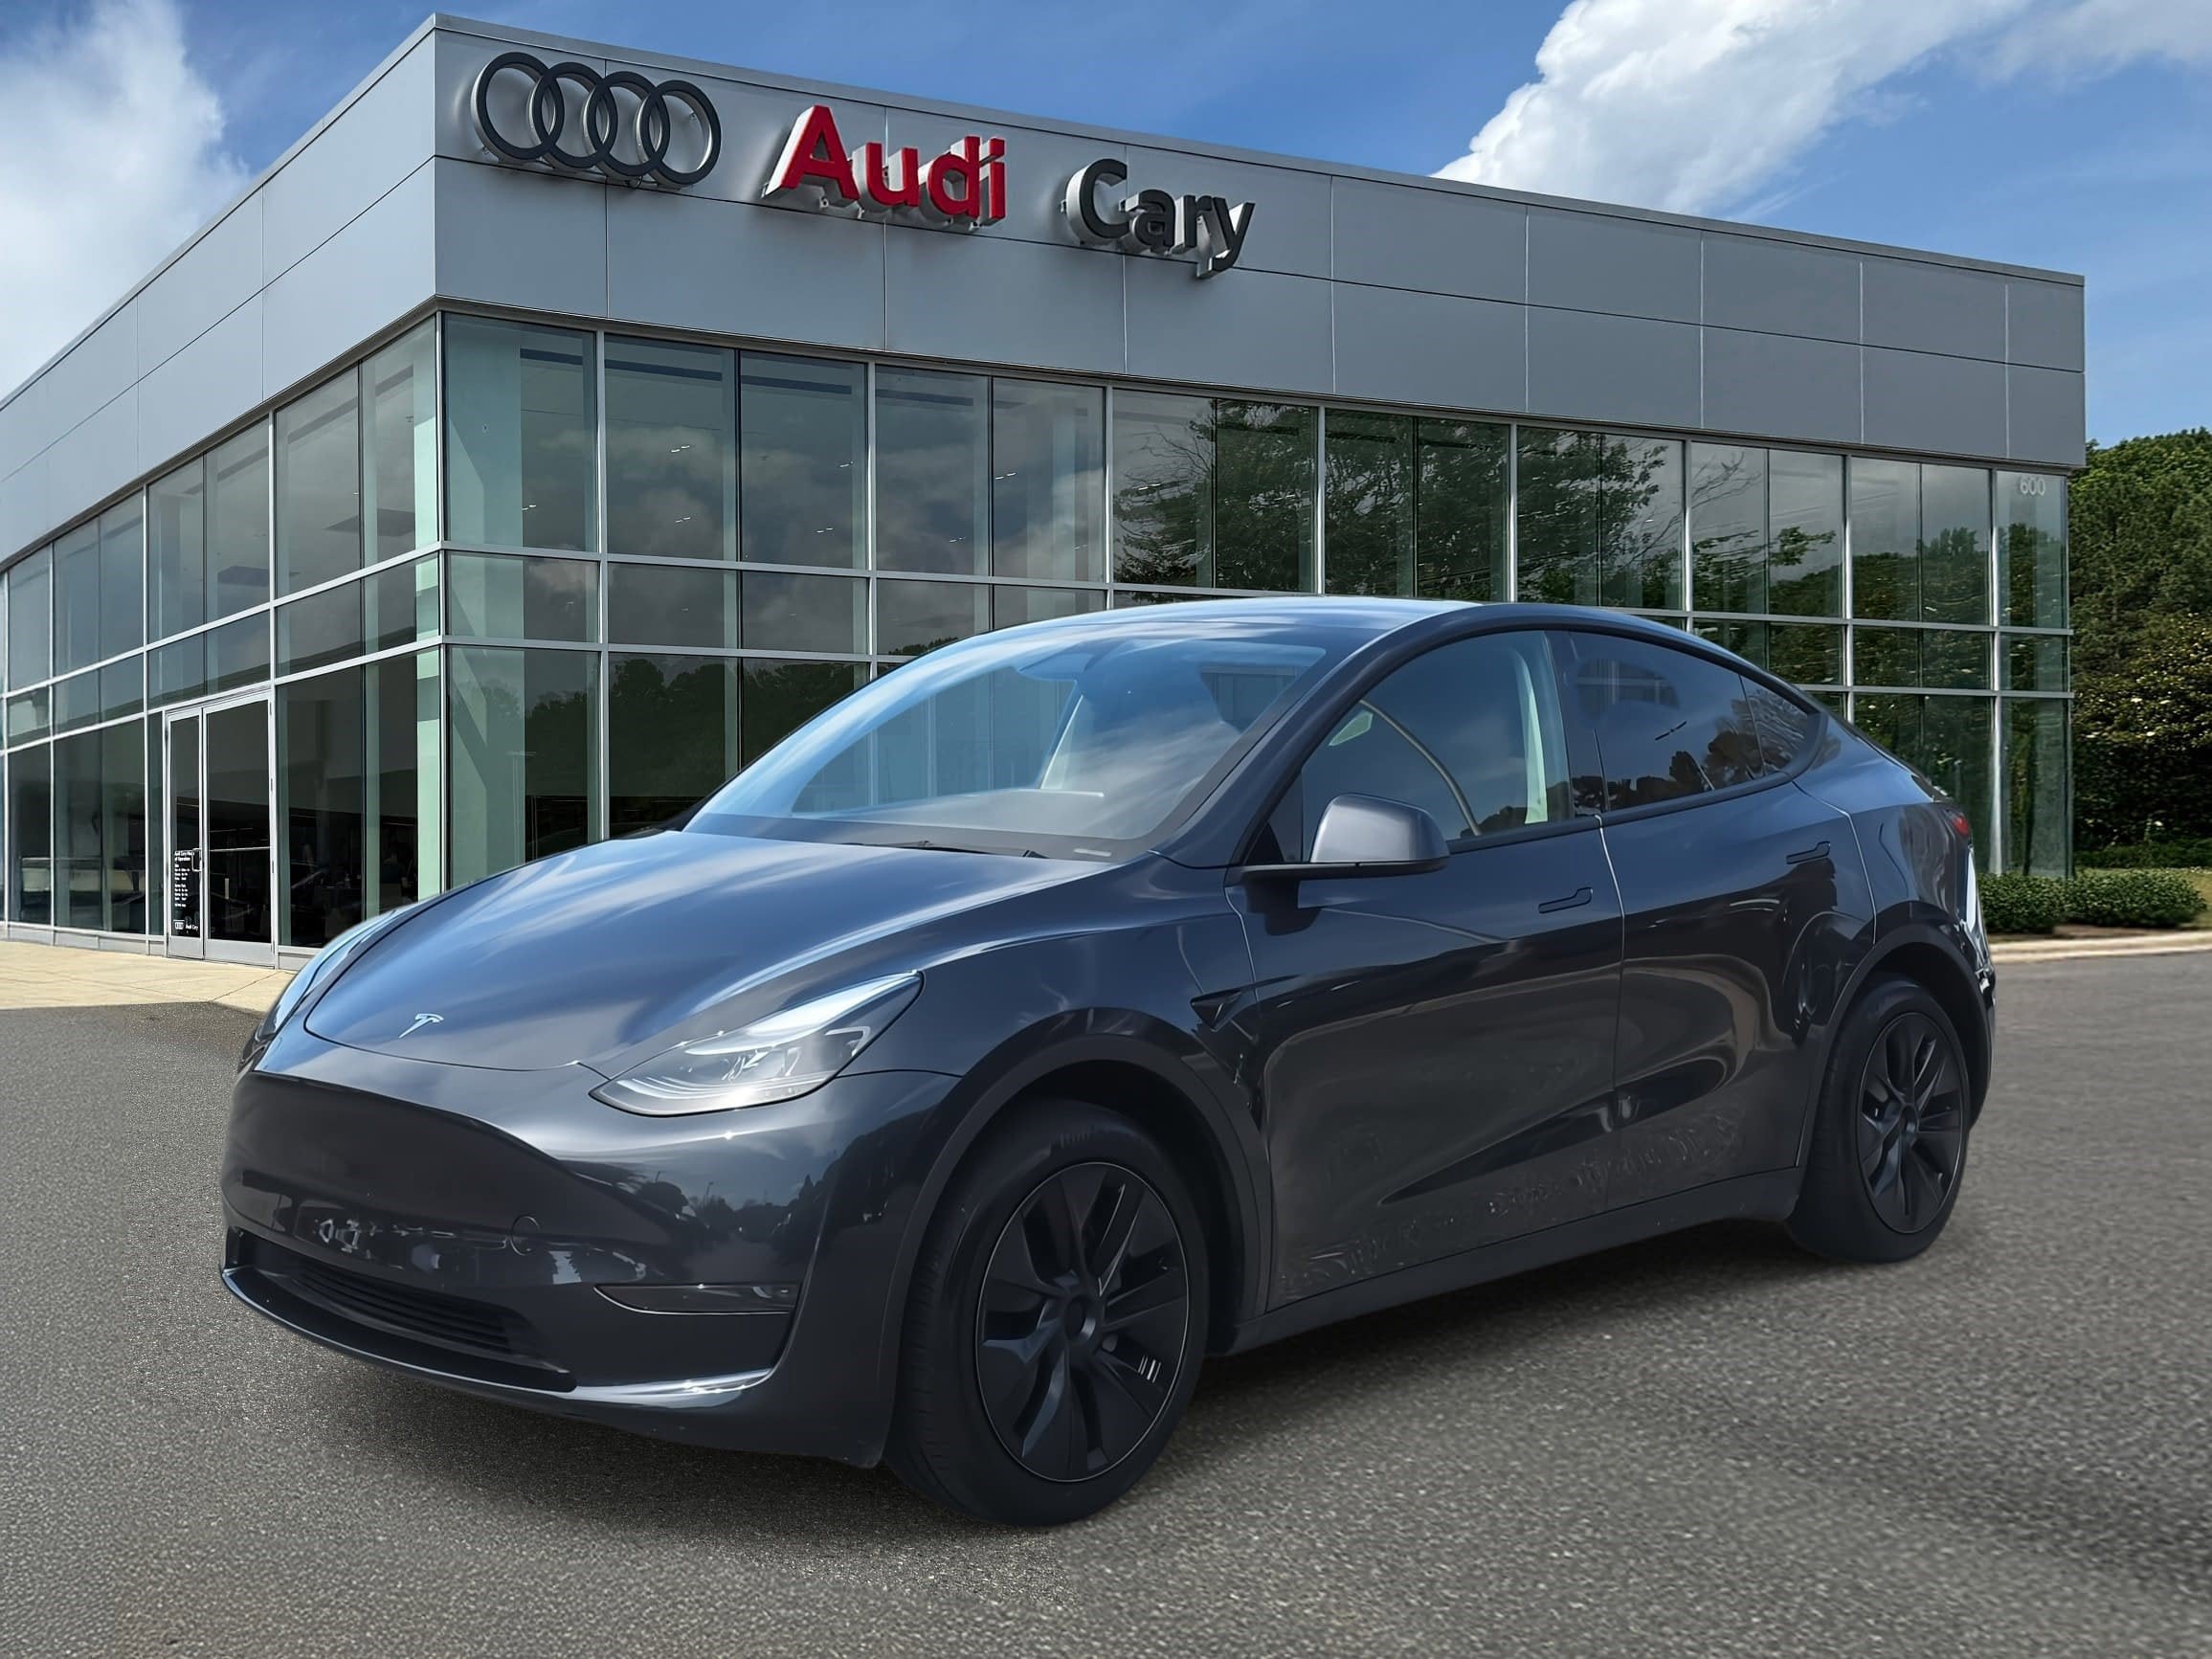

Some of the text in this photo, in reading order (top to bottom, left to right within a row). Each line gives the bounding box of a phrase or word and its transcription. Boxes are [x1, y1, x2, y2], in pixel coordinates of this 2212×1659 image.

[770, 104, 1256, 276] Audi Cary
[2020, 477, 2046, 496] 600
